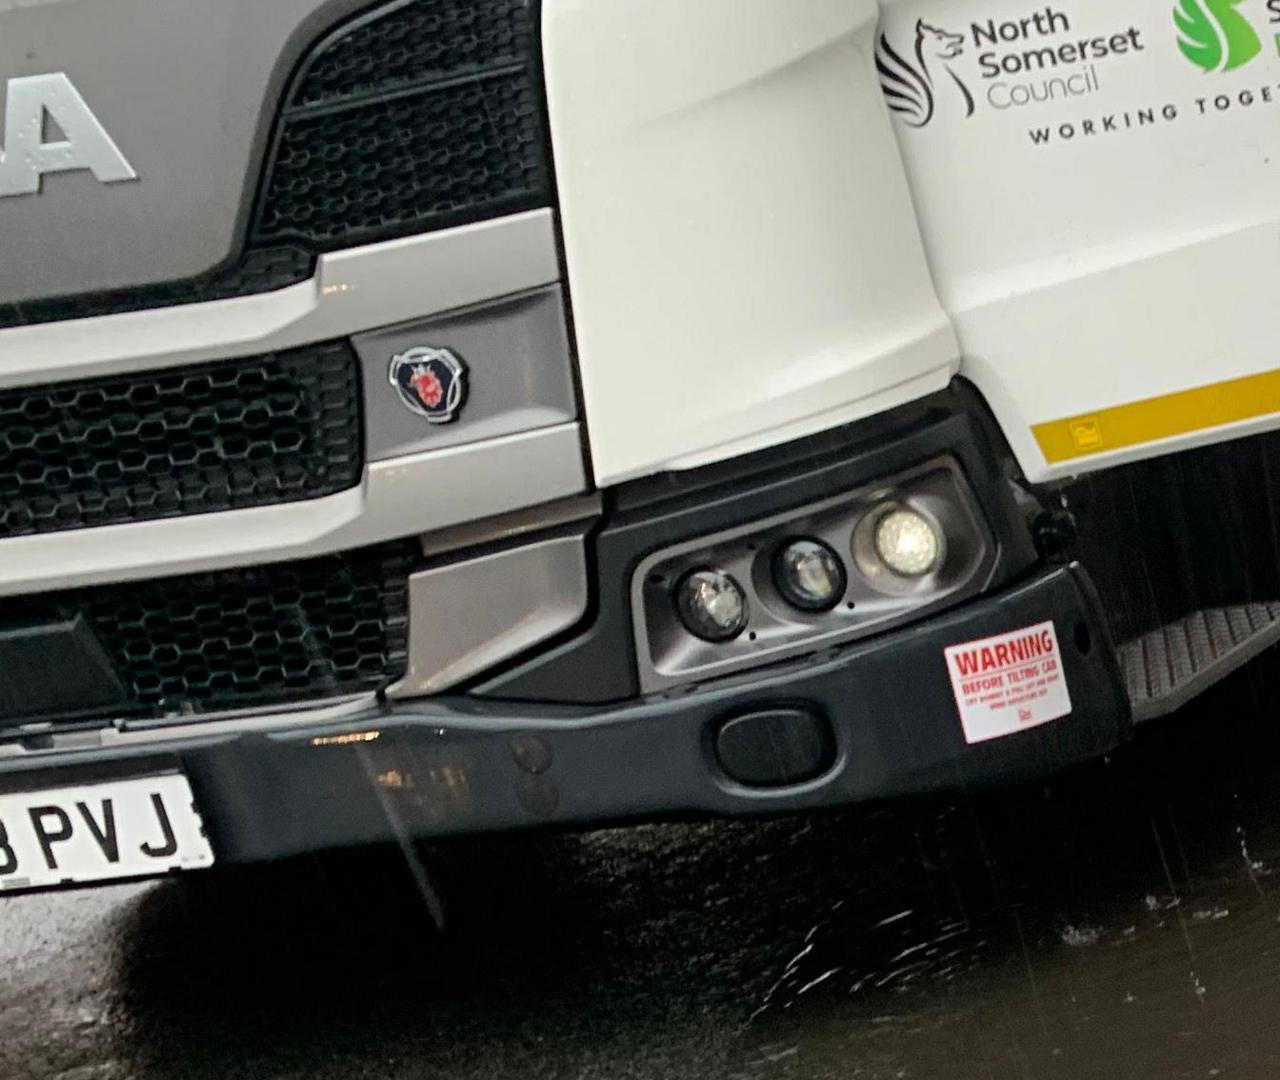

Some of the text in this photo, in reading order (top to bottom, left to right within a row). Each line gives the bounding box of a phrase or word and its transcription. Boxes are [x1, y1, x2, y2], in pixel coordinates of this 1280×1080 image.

[970, 6, 1070, 48] North
[978, 26, 1144, 79] Somerset
[987, 64, 1099, 110] Council
[0, 72, 139, 198] A
[1029, 104, 1177, 145] WORKING
[954, 629, 1054, 676] WARNING
[961, 675, 1004, 696] BEFORE
[1007, 665, 1040, 685] TILTING
